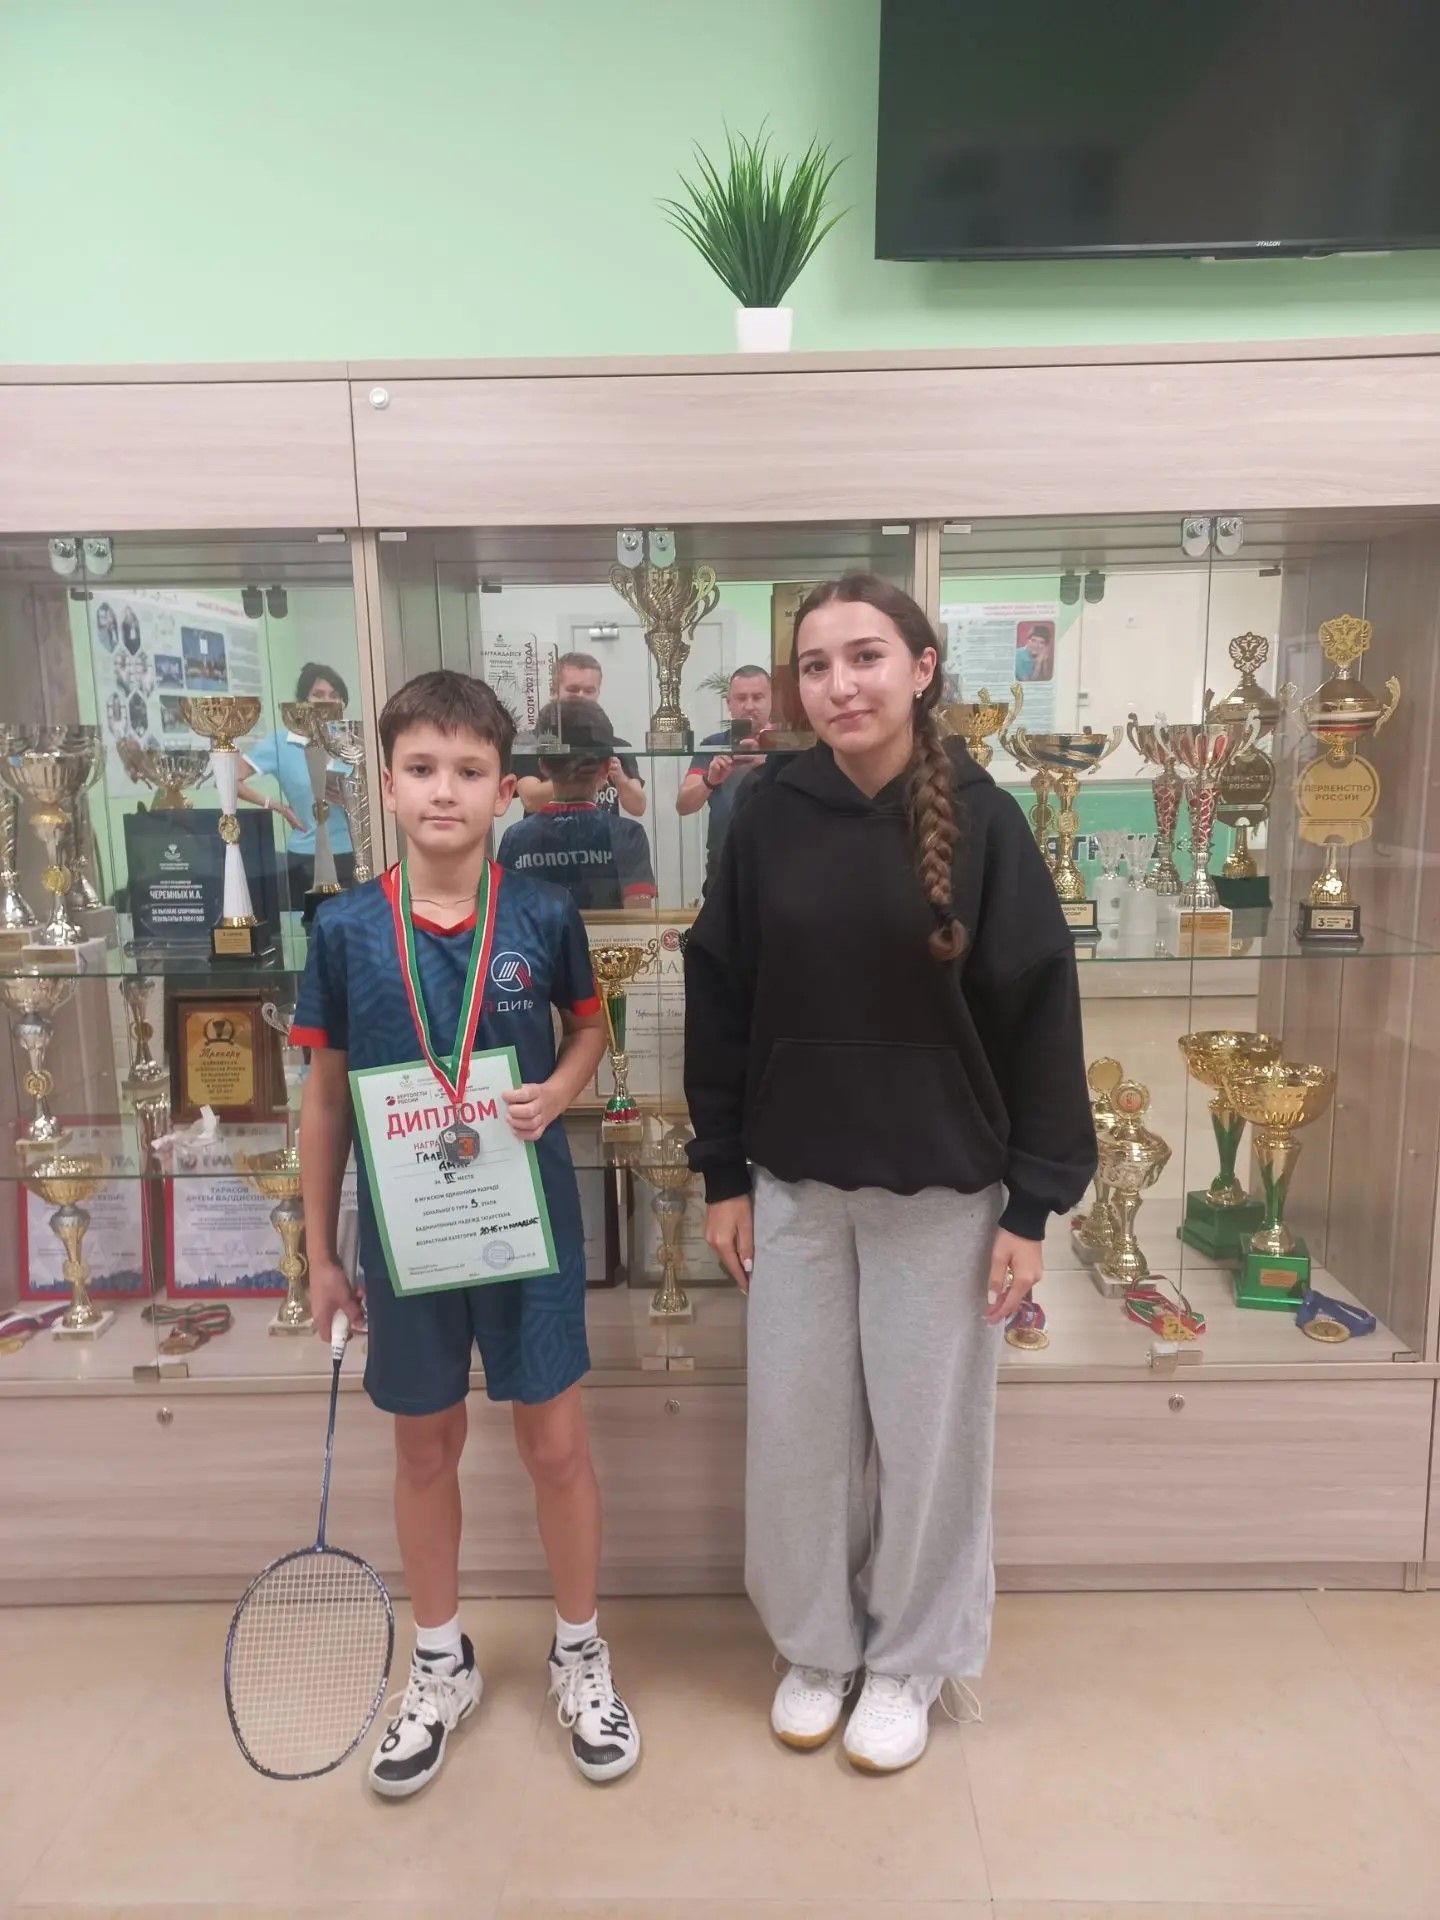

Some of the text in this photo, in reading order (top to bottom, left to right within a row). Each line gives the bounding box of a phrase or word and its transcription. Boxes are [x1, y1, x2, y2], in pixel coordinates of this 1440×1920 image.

[1304, 784, 1372, 792] ПЕРВЕНСТВО
[1314, 793, 1360, 801] РОССИИ
[149, 890, 188, 900] ЧЕРЕМНЫХ
[387, 1099, 498, 1140] ДИПЛОМ
